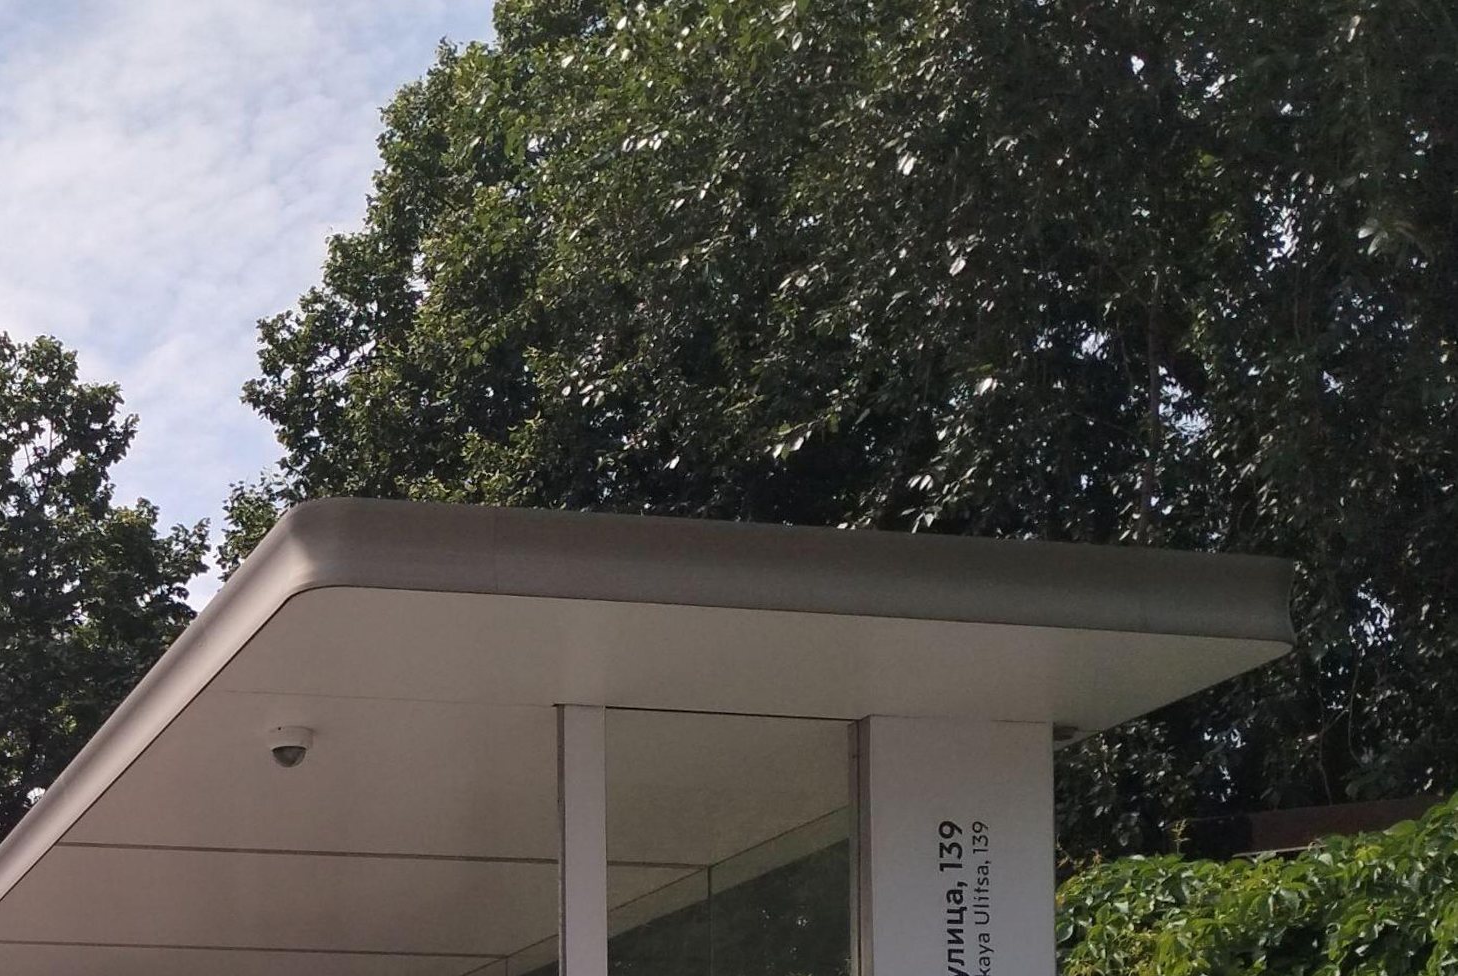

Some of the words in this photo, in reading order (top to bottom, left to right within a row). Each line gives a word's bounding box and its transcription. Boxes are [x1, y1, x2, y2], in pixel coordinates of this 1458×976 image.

[938, 820, 963, 872] 139
[972, 821, 989, 855] 139
[973, 860, 992, 926] Ulitsa,
